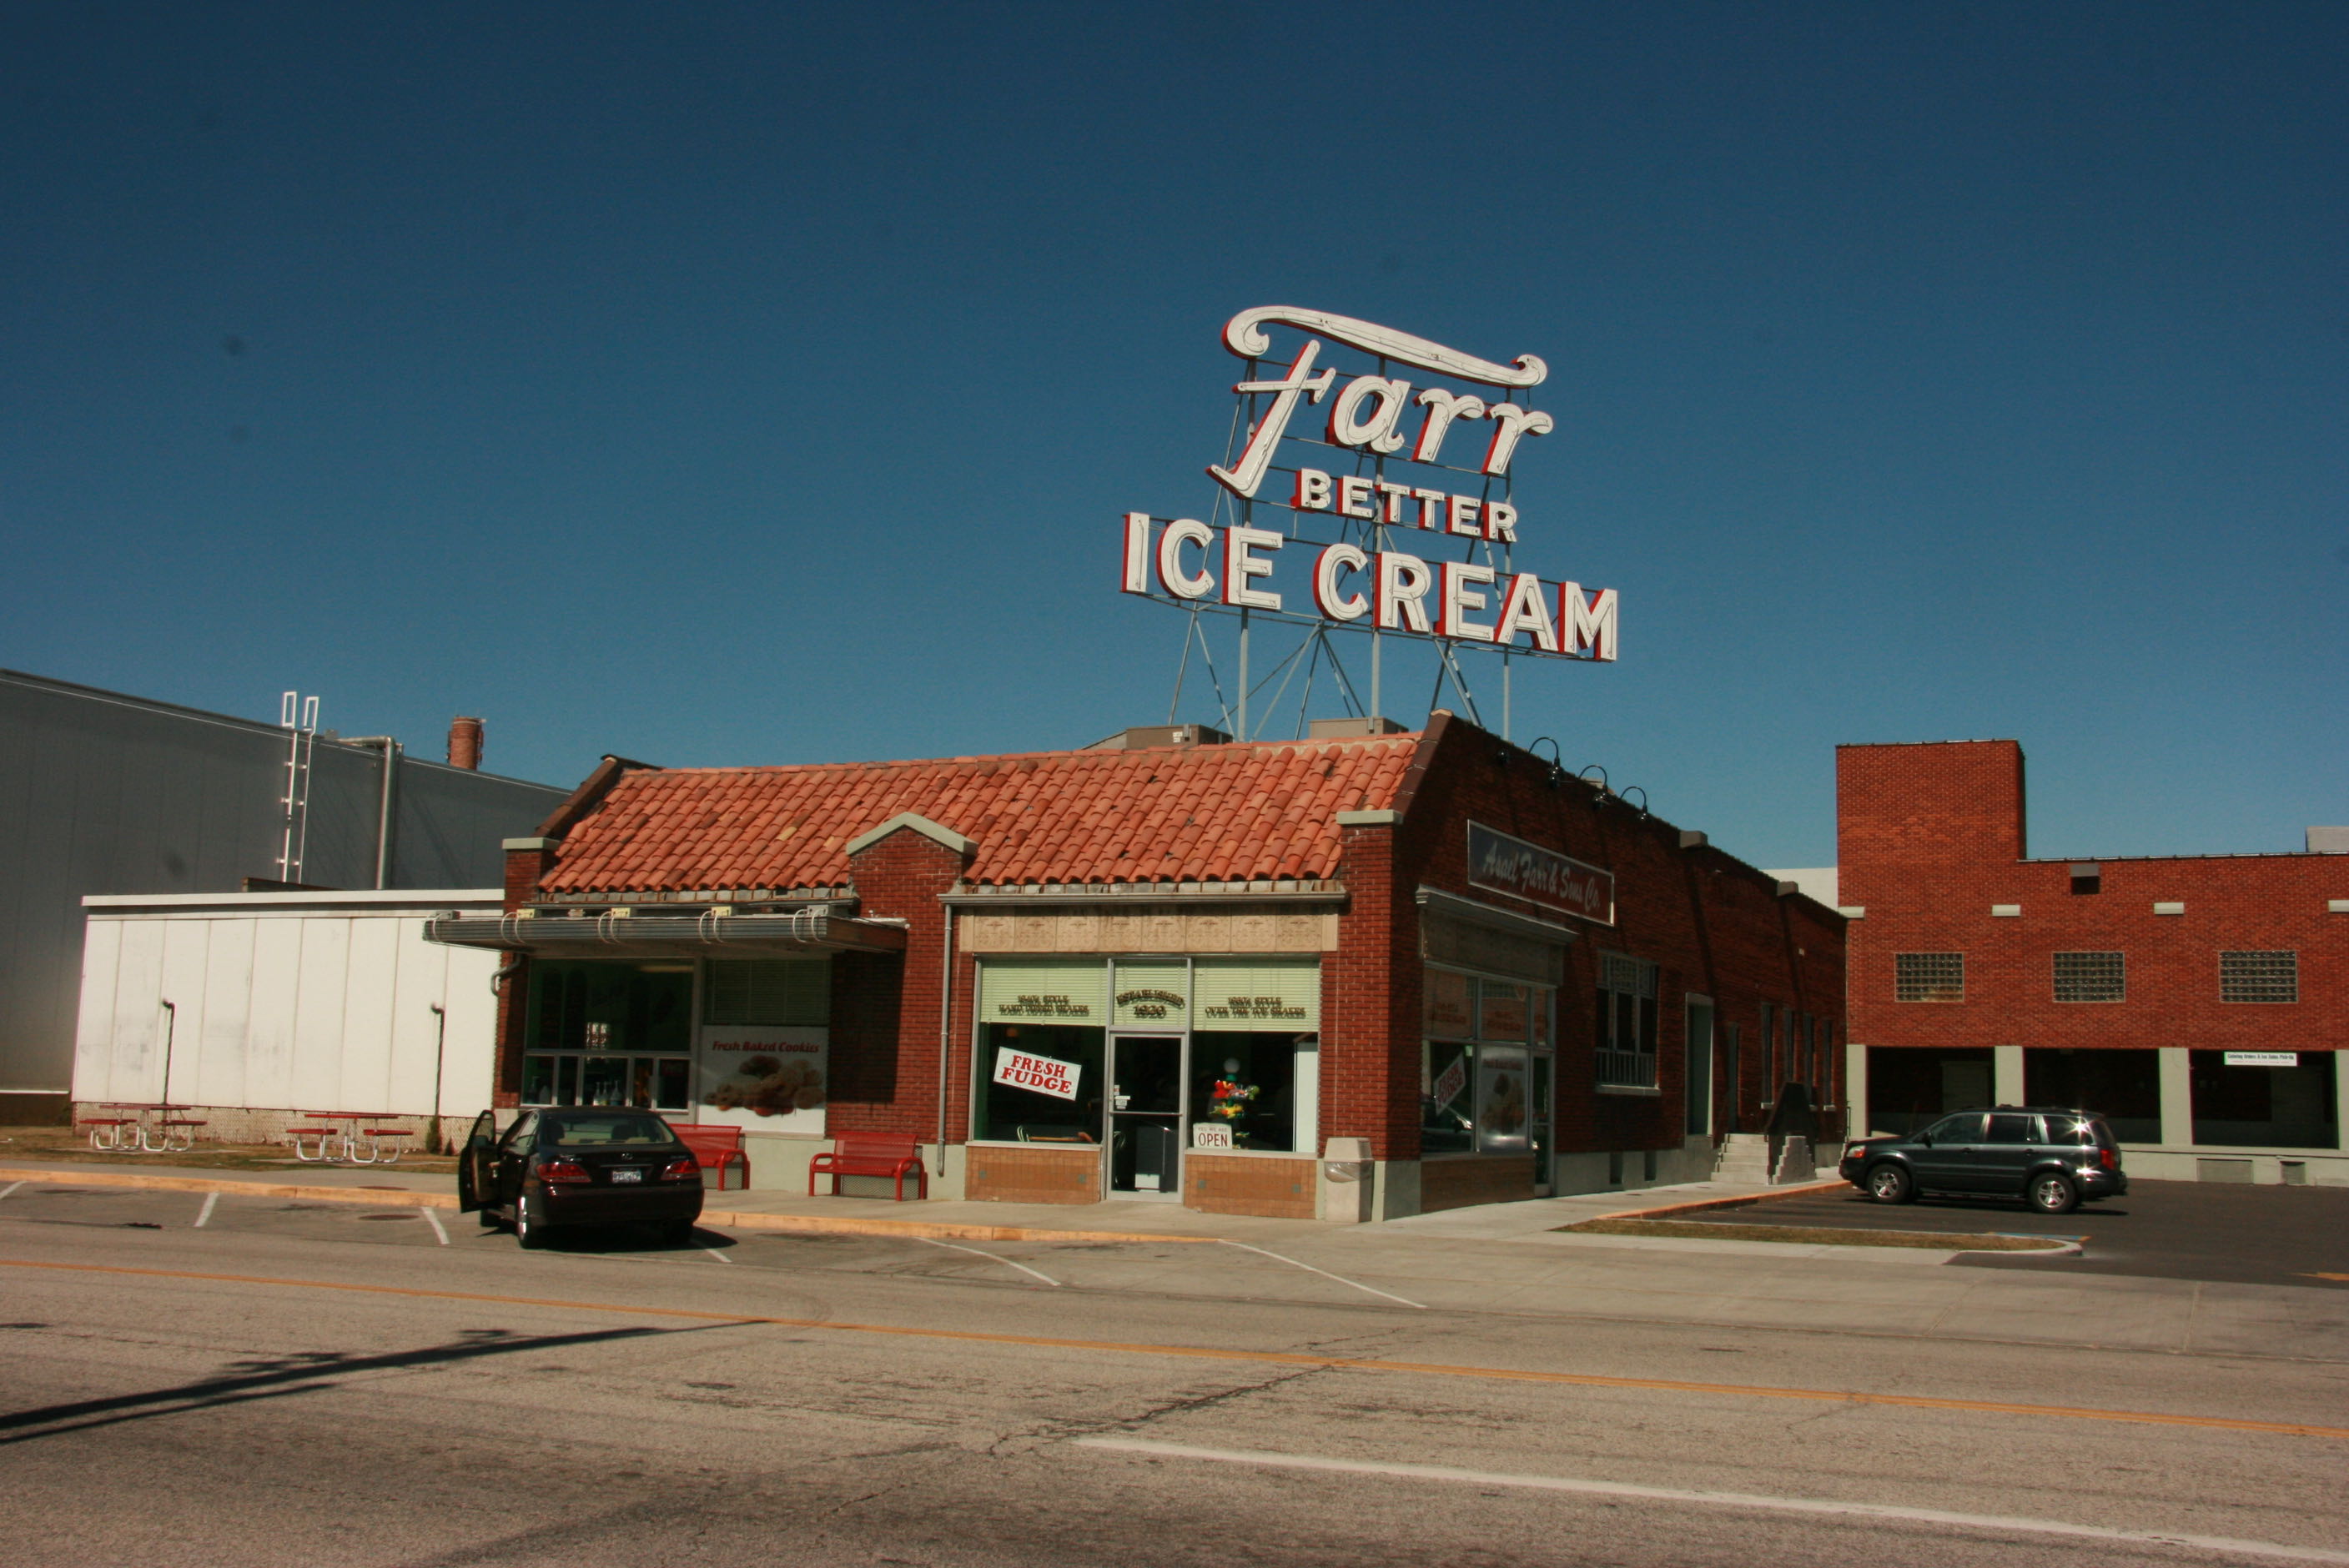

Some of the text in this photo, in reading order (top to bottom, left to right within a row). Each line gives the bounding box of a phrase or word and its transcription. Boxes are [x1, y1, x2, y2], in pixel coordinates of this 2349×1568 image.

[1292, 467, 1517, 543] BETTER
[1121, 511, 1617, 661] ICE CREAM
[1585, 877, 1601, 912] Co.
[1205, 1007, 1228, 1015] OVER
[1270, 1008, 1305, 1016] SHAKES
[1254, 997, 1282, 1006] STYLE
[712, 1041, 820, 1053] Fresh Baked Cookies
[1011, 1055, 1067, 1078] FRESH
[1001, 1067, 1072, 1093] FUDGE
[1198, 1133, 1228, 1147] OPEN
